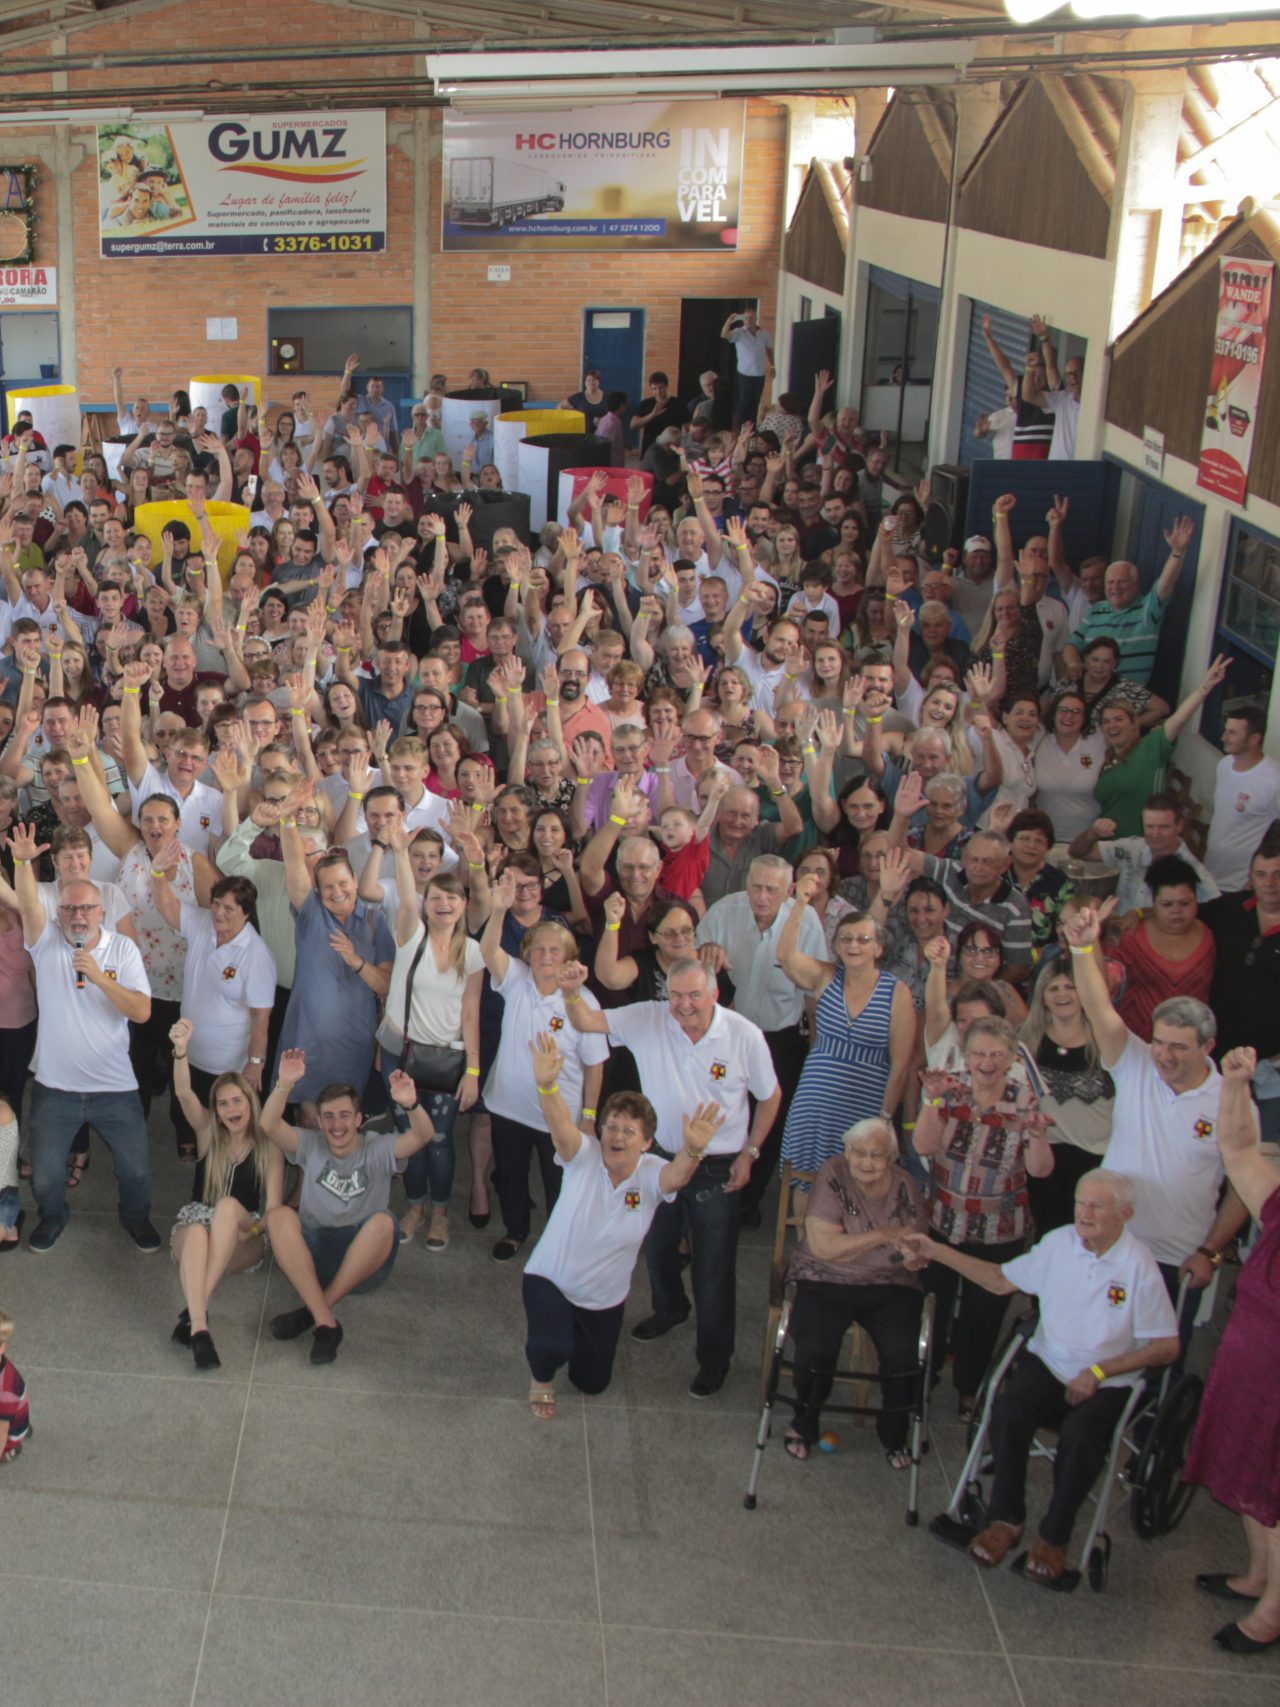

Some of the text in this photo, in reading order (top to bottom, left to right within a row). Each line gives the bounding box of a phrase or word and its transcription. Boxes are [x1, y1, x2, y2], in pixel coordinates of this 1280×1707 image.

[272, 120, 348, 129] SUPERMERCADOS
[208, 122, 347, 162] GUMZ
[679, 127, 729, 166] IN
[678, 167, 727, 185] COM
[220, 190, 358, 209] Lugar de família feliz!
[677, 185, 727, 200] PARA
[207, 207, 372, 218] Supermercado, panificadora, lanchonete
[677, 200, 727, 222] VEL
[260, 219, 306, 228] construção
[315, 218, 370, 227] agropecuária
[508, 224, 597, 234] www.hchornburg.com.br
[110, 235, 373, 254] supergumz@terra.com.br 3376-1031
[9, 286, 47, 296] CAMARÃO
[1226, 286, 1262, 304] WANDE
